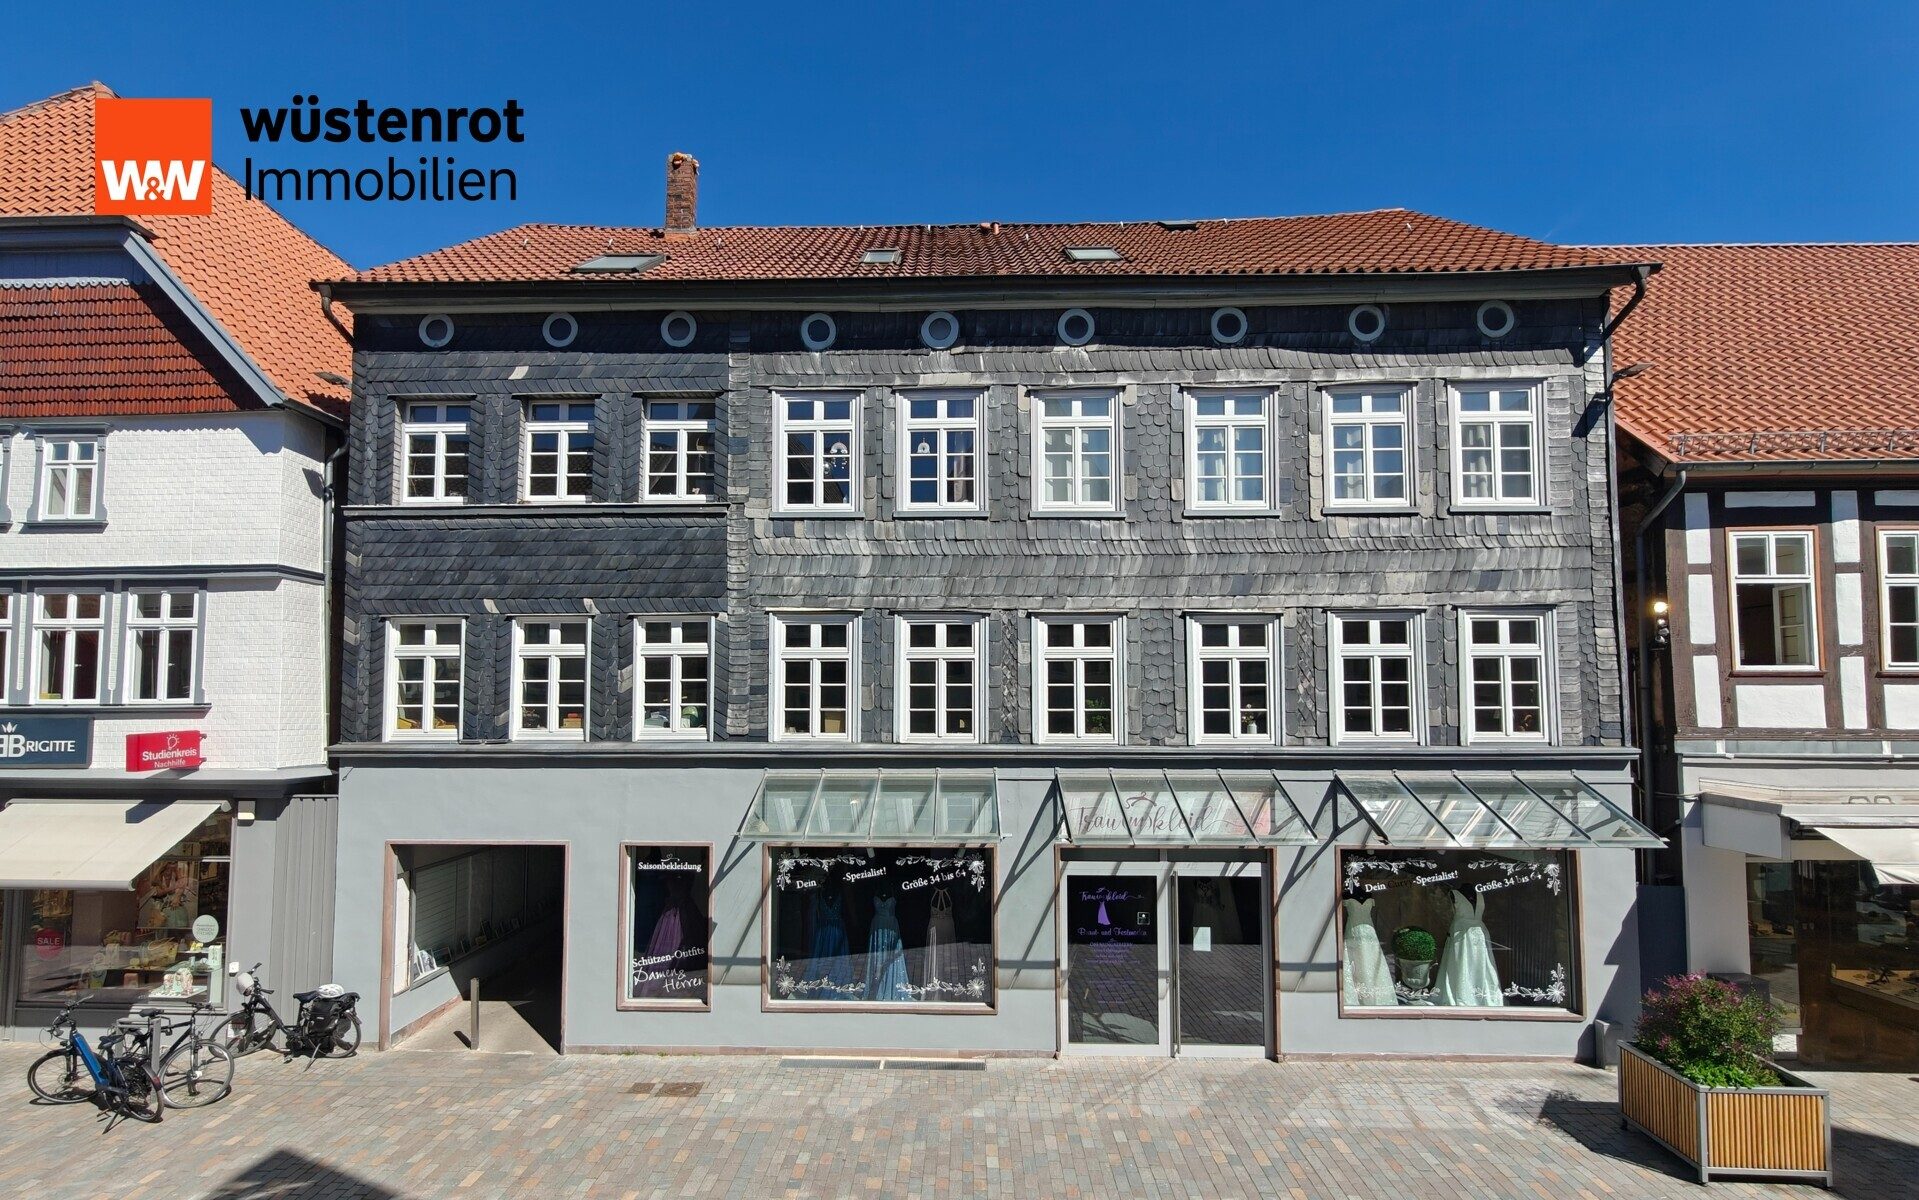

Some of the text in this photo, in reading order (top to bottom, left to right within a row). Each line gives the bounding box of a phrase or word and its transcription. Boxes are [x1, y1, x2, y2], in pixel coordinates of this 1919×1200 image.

[142, 747, 197, 762] Studienkreis
[154, 759, 186, 769] Nachhilfe
[638, 861, 702, 873] Saisonbekleidung
[796, 878, 817, 890] Dein
[901, 868, 966, 891] Größe 34 bis 64
[1474, 879, 1503, 893] Größe
[1503, 876, 1515, 888] 34
[1515, 874, 1529, 884] bis
[1365, 882, 1387, 893] Dein
[37, 937, 61, 946] SALE
[632, 947, 705, 968] Schützen-Outfits
[662, 976, 706, 993] Herren
